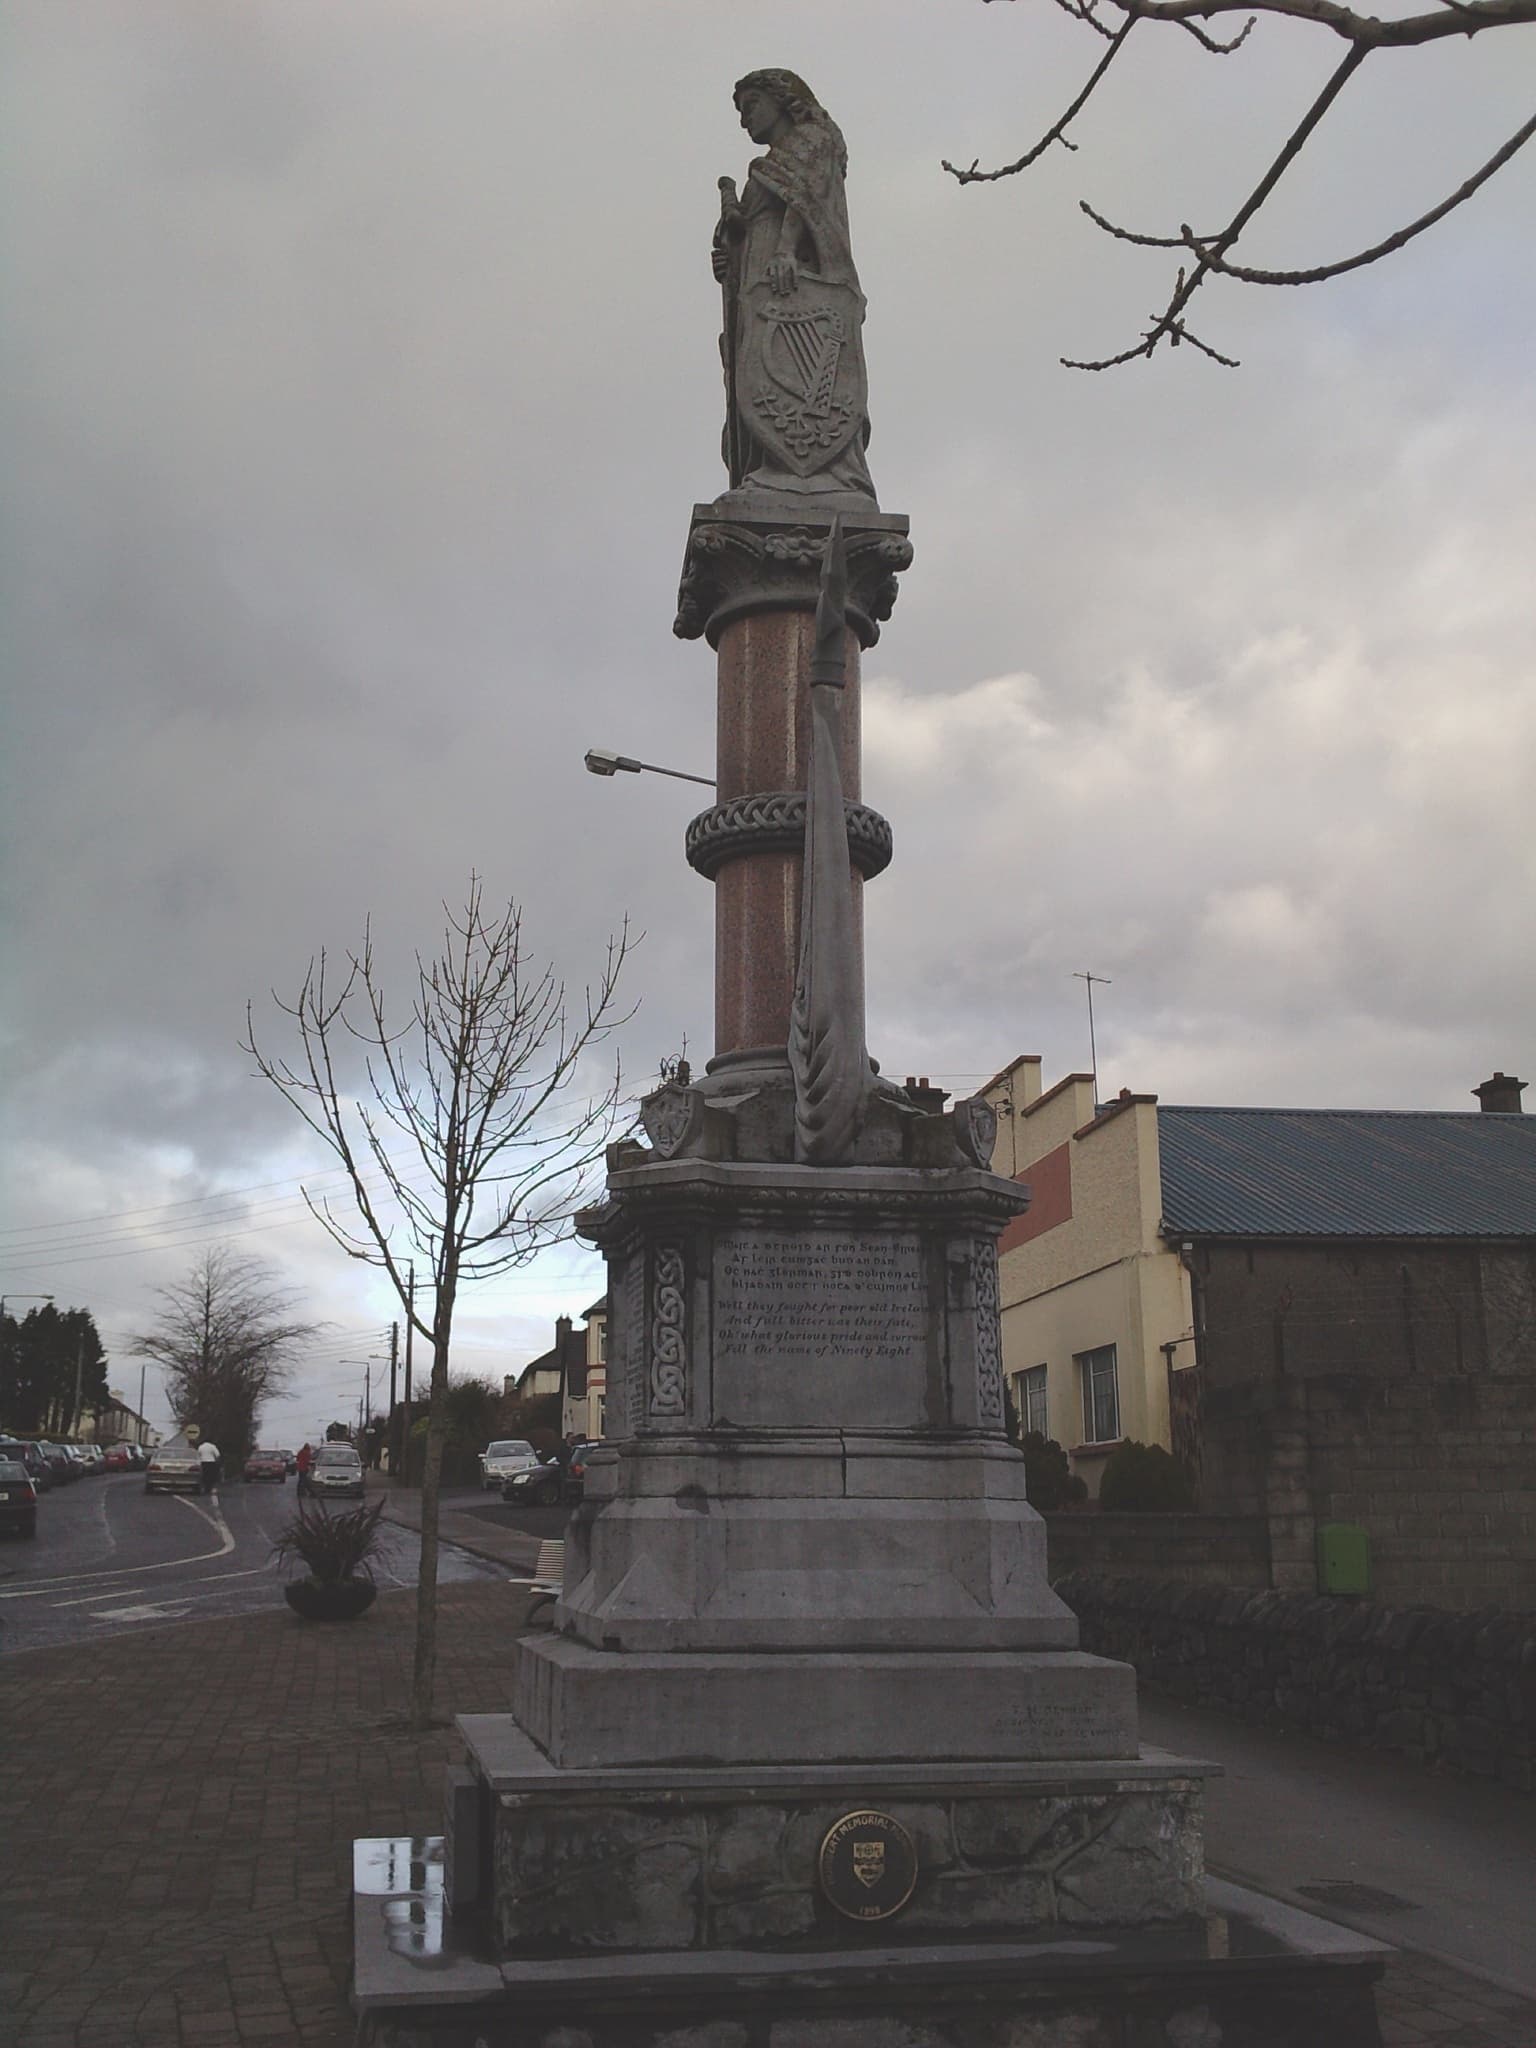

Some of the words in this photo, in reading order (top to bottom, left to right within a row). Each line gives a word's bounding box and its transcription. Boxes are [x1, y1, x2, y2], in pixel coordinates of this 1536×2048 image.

[747, 1301, 775, 1314] they
[774, 1301, 818, 1314] fought
[819, 1301, 837, 1314] for
[839, 1304, 867, 1314] poor
[868, 1303, 888, 1312] old
[725, 1315, 753, 1325] And
[790, 1315, 825, 1326] bitter
[854, 1316, 883, 1327] their
[740, 1329, 772, 1340] what
[775, 1330, 827, 1344] glorious
[829, 1330, 863, 1344] pride
[864, 1330, 888, 1342] and
[814, 1344, 830, 1358] of
[830, 1345, 873, 1358] Ninety
[876, 1345, 911, 1360] Eight
[838, 1815, 889, 1837] MEMORIAL
